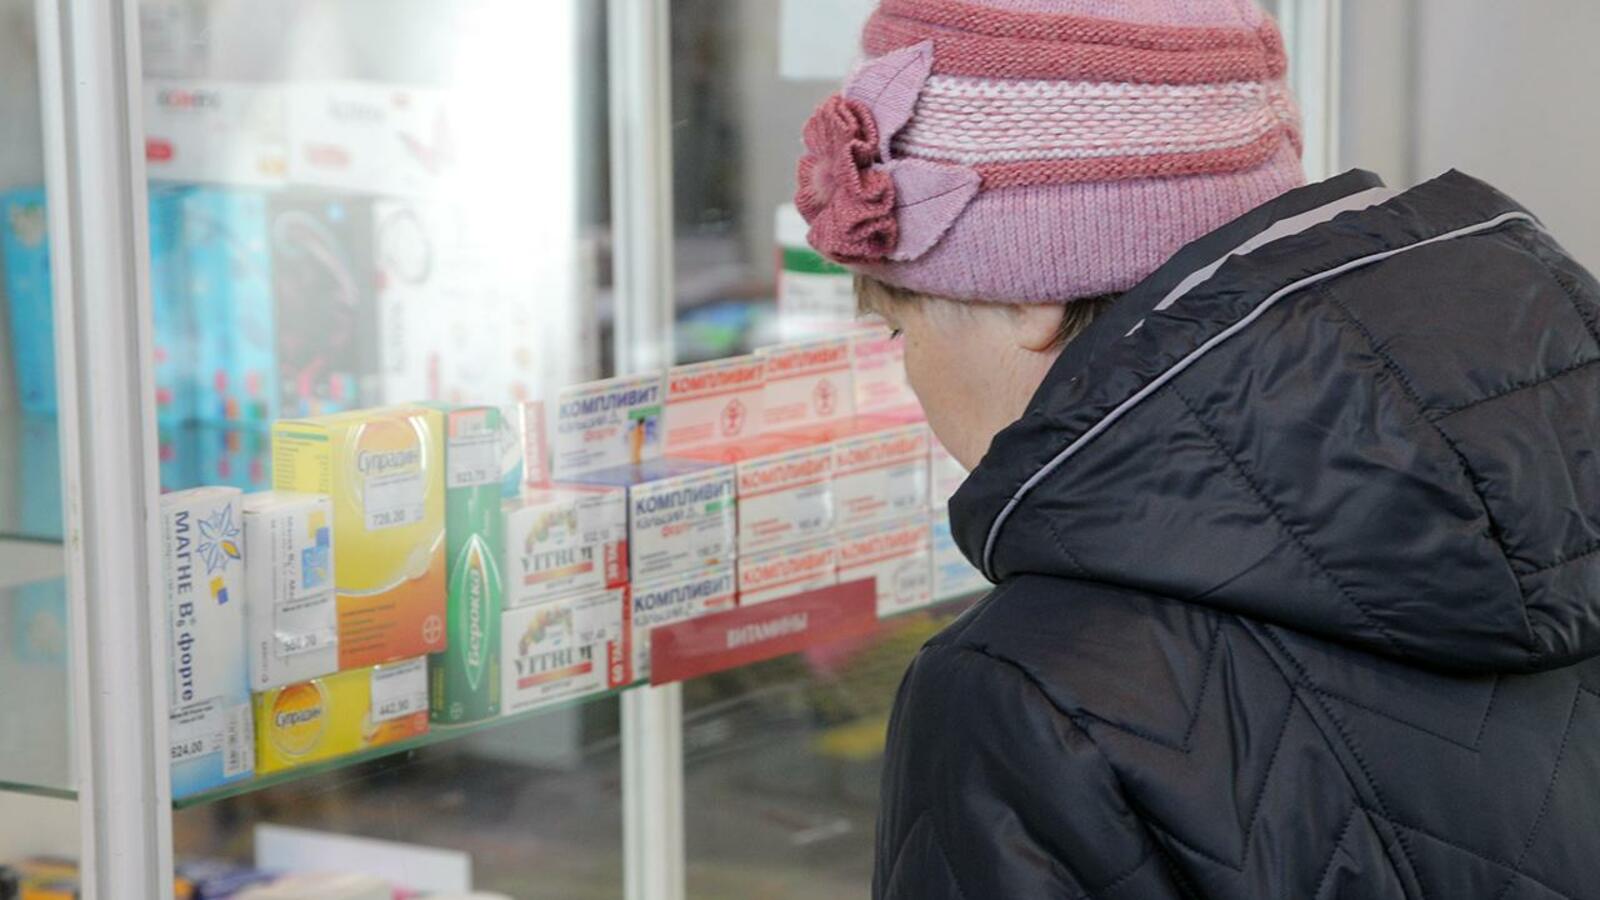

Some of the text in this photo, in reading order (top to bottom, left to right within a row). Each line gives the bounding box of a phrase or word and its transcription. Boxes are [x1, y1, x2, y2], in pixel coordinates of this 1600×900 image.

[669, 364, 764, 394] КОМПЛИВИТ
[559, 385, 658, 418] КОМПЛИВИТ
[636, 479, 731, 516] КОМПЛИВИТ
[175, 511, 193, 595] МАГНЕ
[634, 574, 732, 613] КОМПЛИВИТ
[727, 611, 808, 649] ВИТАМИНЫ
[177, 632, 195, 702] форте
